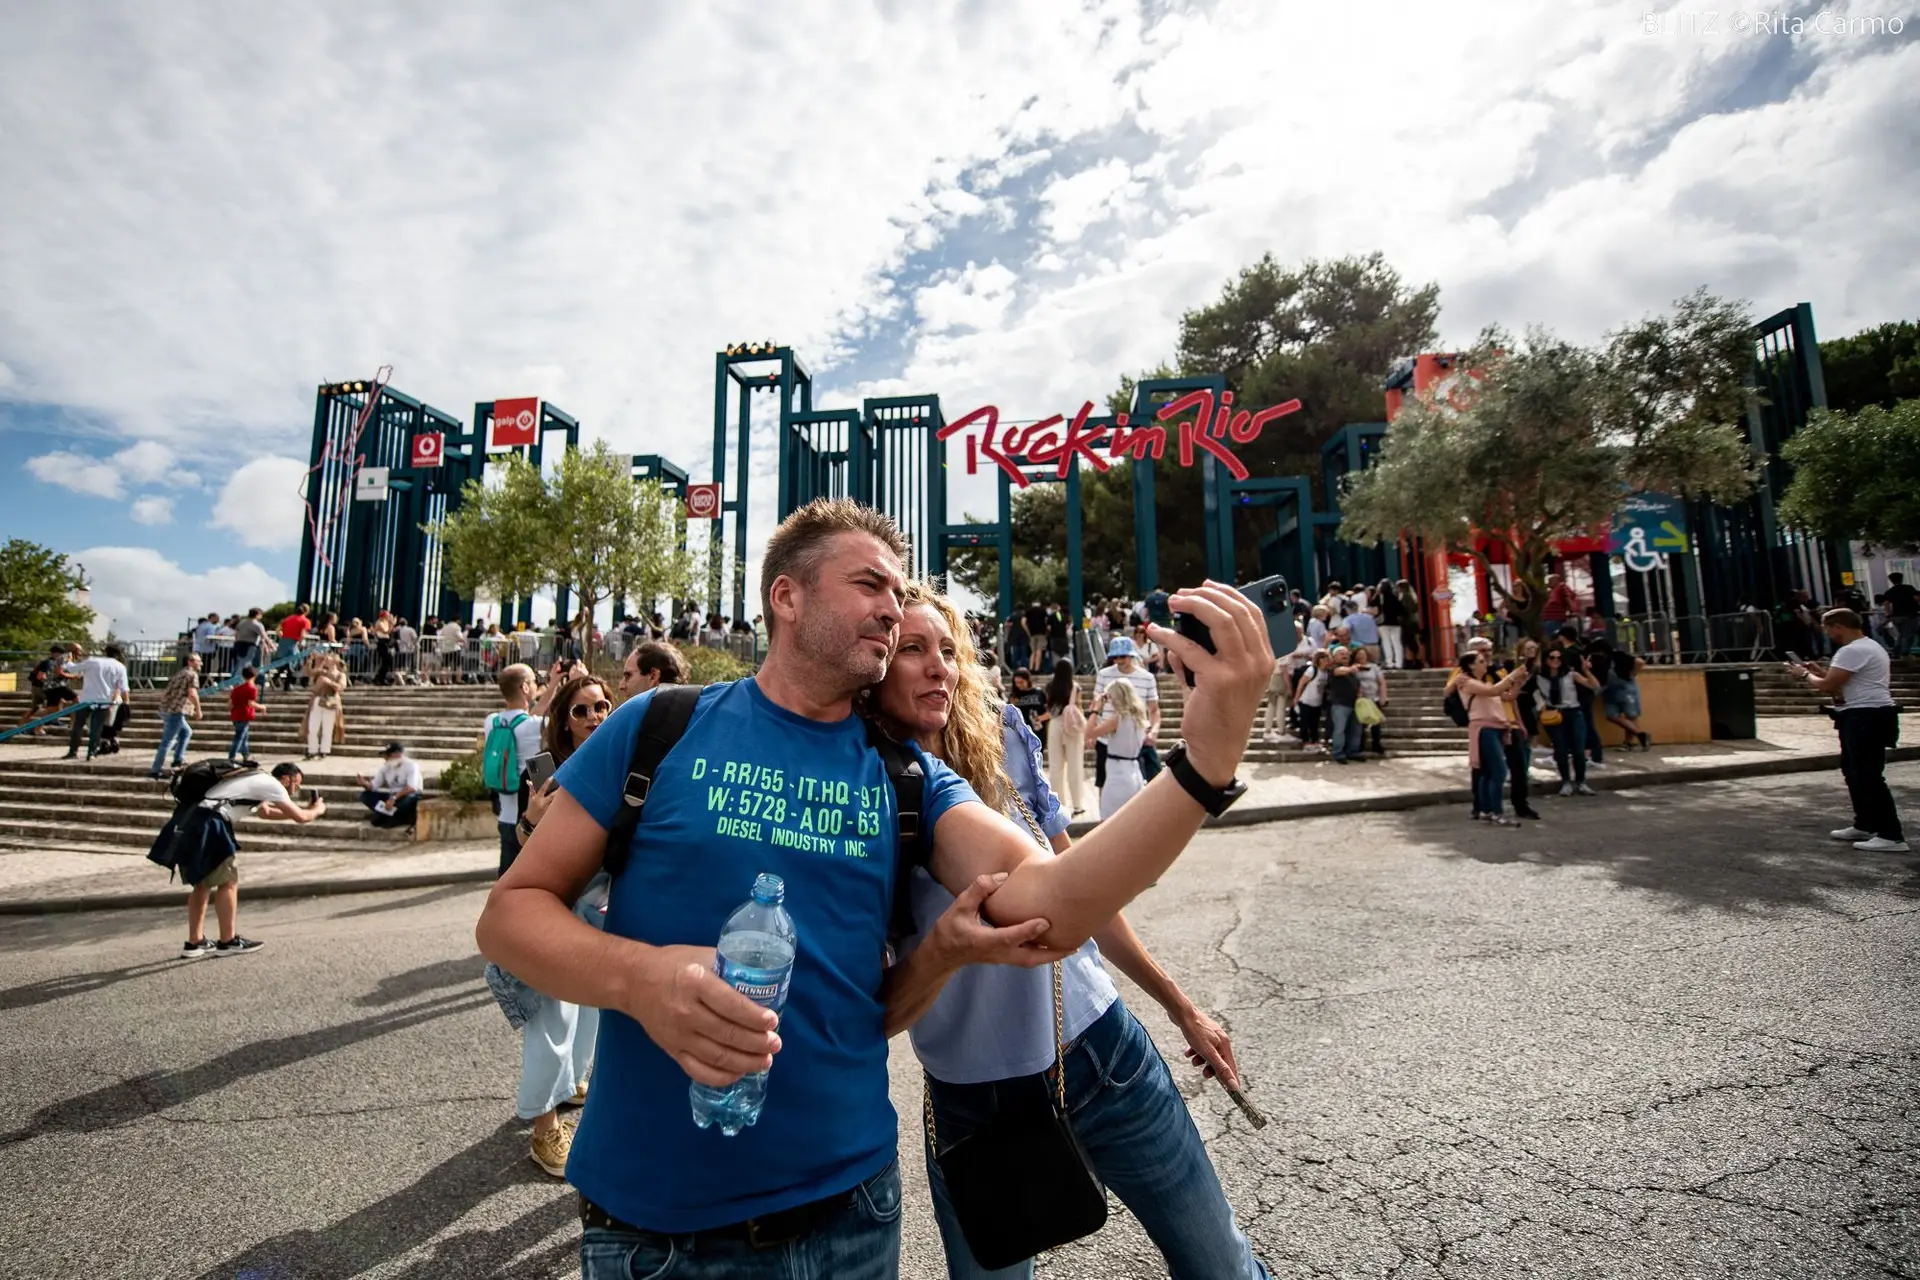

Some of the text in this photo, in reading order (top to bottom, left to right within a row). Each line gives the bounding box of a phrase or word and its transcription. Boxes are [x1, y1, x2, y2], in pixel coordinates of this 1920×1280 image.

[936, 390, 1302, 488] Rock in Rio
[716, 816, 868, 858] DIESEL INDUSTRY INC.
[738, 984, 776, 996] HENNIEZ
